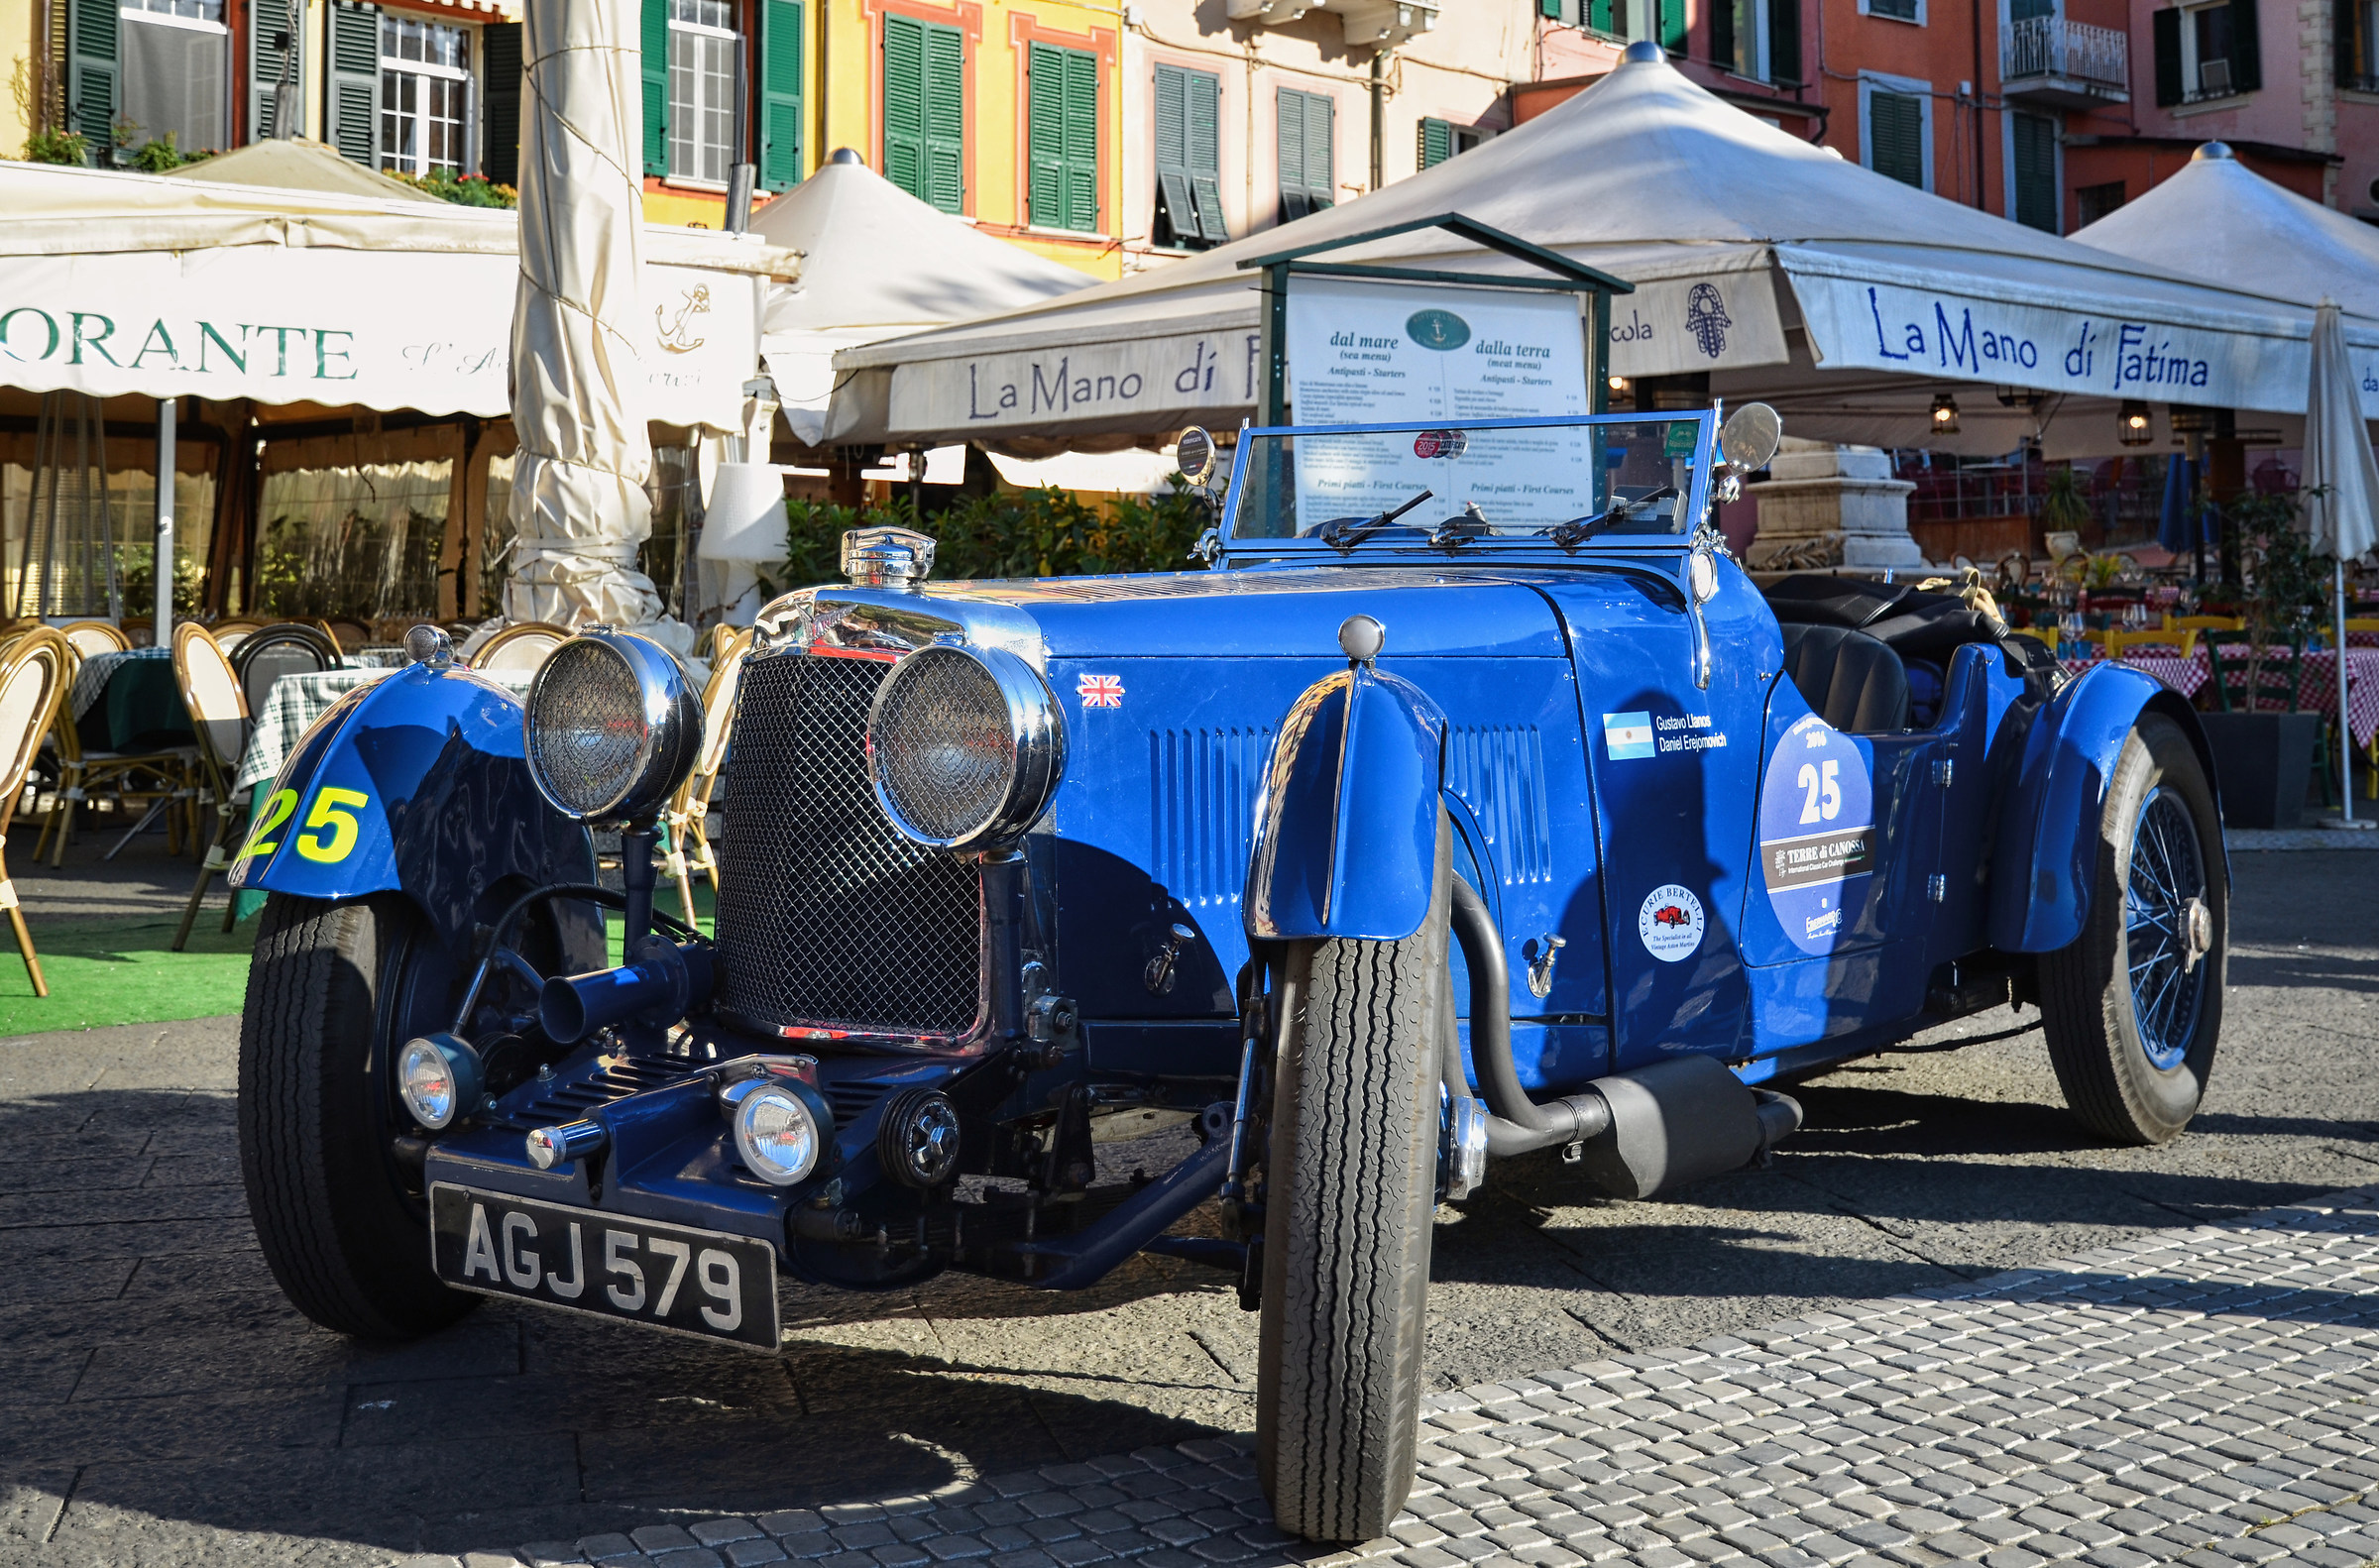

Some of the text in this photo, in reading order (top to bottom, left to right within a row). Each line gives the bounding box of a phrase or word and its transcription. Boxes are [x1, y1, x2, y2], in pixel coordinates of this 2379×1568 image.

[0, 307, 359, 380] ORANTE
[1330, 331, 1355, 347] dal
[1359, 336, 1399, 349] mare
[1868, 286, 2208, 391] La Mano di Fatima
[1339, 350, 1392, 363] (sea menu)
[1475, 339, 1512, 356] dalla
[1517, 344, 1550, 358] terra
[1327, 366, 1366, 378] Antipasti
[1373, 368, 1406, 379] Starters
[1487, 358, 1541, 371] (meat menu)
[968, 363, 1018, 419] La
[1031, 356, 1142, 414] Mano
[1175, 341, 1216, 392] di
[1480, 374, 1516, 386] Antipasti
[1522, 376, 1552, 387] Starters
[1417, 441, 1436, 451] 2015
[1317, 479, 1342, 490] Primi
[1373, 481, 1393, 490] First
[1395, 482, 1427, 492] Courses
[1471, 483, 1494, 493] Primi
[1495, 484, 1516, 496] piatti
[1523, 485, 1541, 494] First
[1543, 485, 1574, 496] Courses
[1655, 713, 1712, 730] Gustavo Llanos
[1658, 731, 1727, 752] Daniel Erejomovich
[1797, 759, 1841, 825] 25
[235, 787, 369, 863] 25
[1787, 839, 1866, 864] TERRE di CANOSSA
[1641, 886, 1703, 938] ECURIE BERTELLI
[1662, 934, 1680, 943] Specialist
[464, 1202, 742, 1331] AGJ 579
